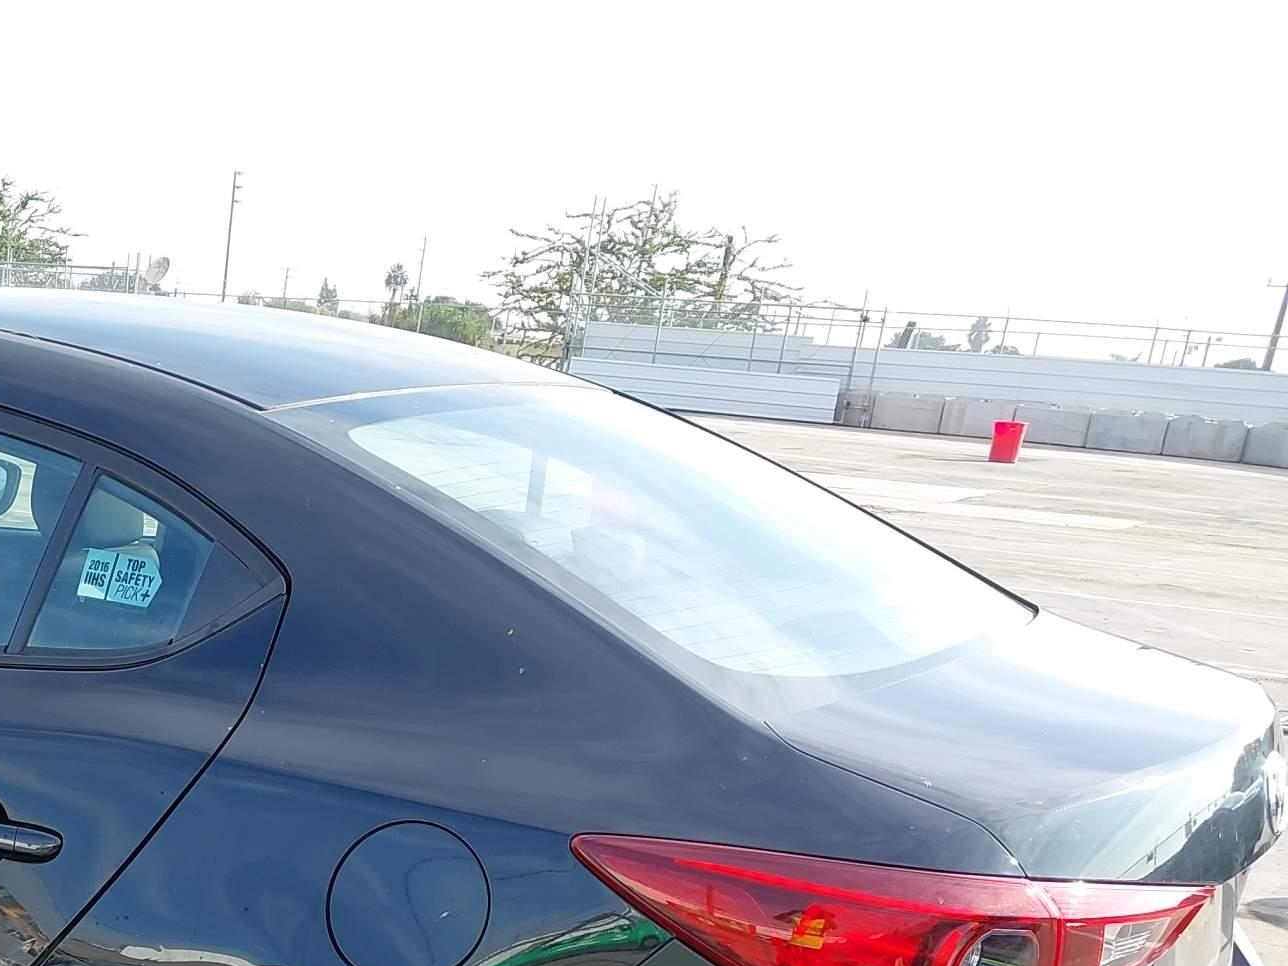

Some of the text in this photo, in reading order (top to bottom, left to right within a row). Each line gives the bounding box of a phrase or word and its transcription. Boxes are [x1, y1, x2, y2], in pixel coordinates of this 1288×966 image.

[88, 559, 110, 572] 2016
[127, 558, 146, 573] TOP
[84, 571, 106, 587] IIHS
[115, 570, 155, 587] SAFETY
